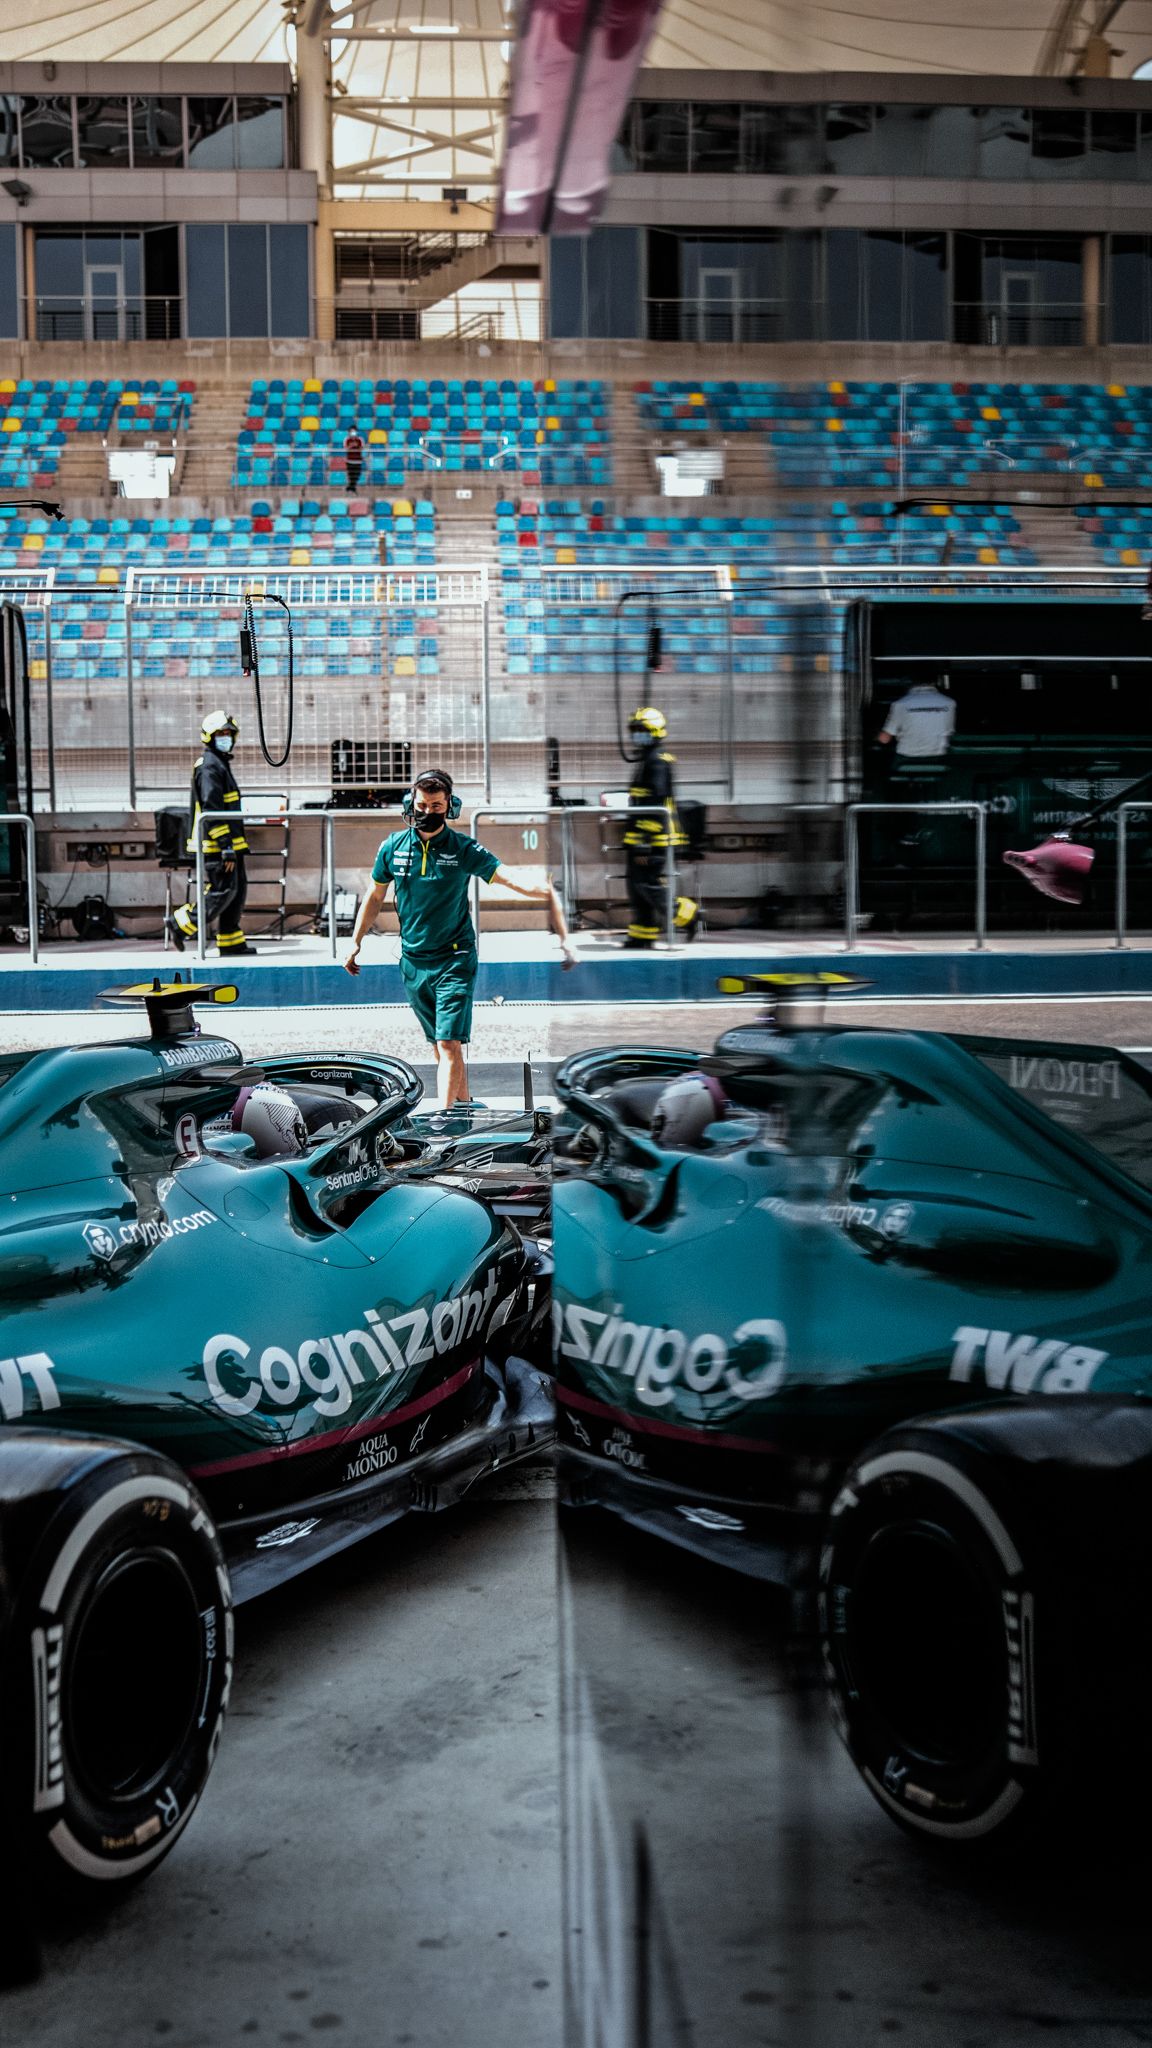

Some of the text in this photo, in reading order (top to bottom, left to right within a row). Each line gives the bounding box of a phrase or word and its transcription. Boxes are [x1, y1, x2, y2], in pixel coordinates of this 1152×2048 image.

[521, 829, 539, 850] 10
[159, 1041, 240, 1067] BOMBARDIER
[310, 1069, 353, 1080] Cognizant
[325, 1164, 378, 1191] SentinelOne
[119, 1210, 218, 1247] crypto.com
[202, 1266, 500, 1417] Cognizant
[357, 1433, 389, 1457] AQUA
[346, 1445, 398, 1481] MONDO
